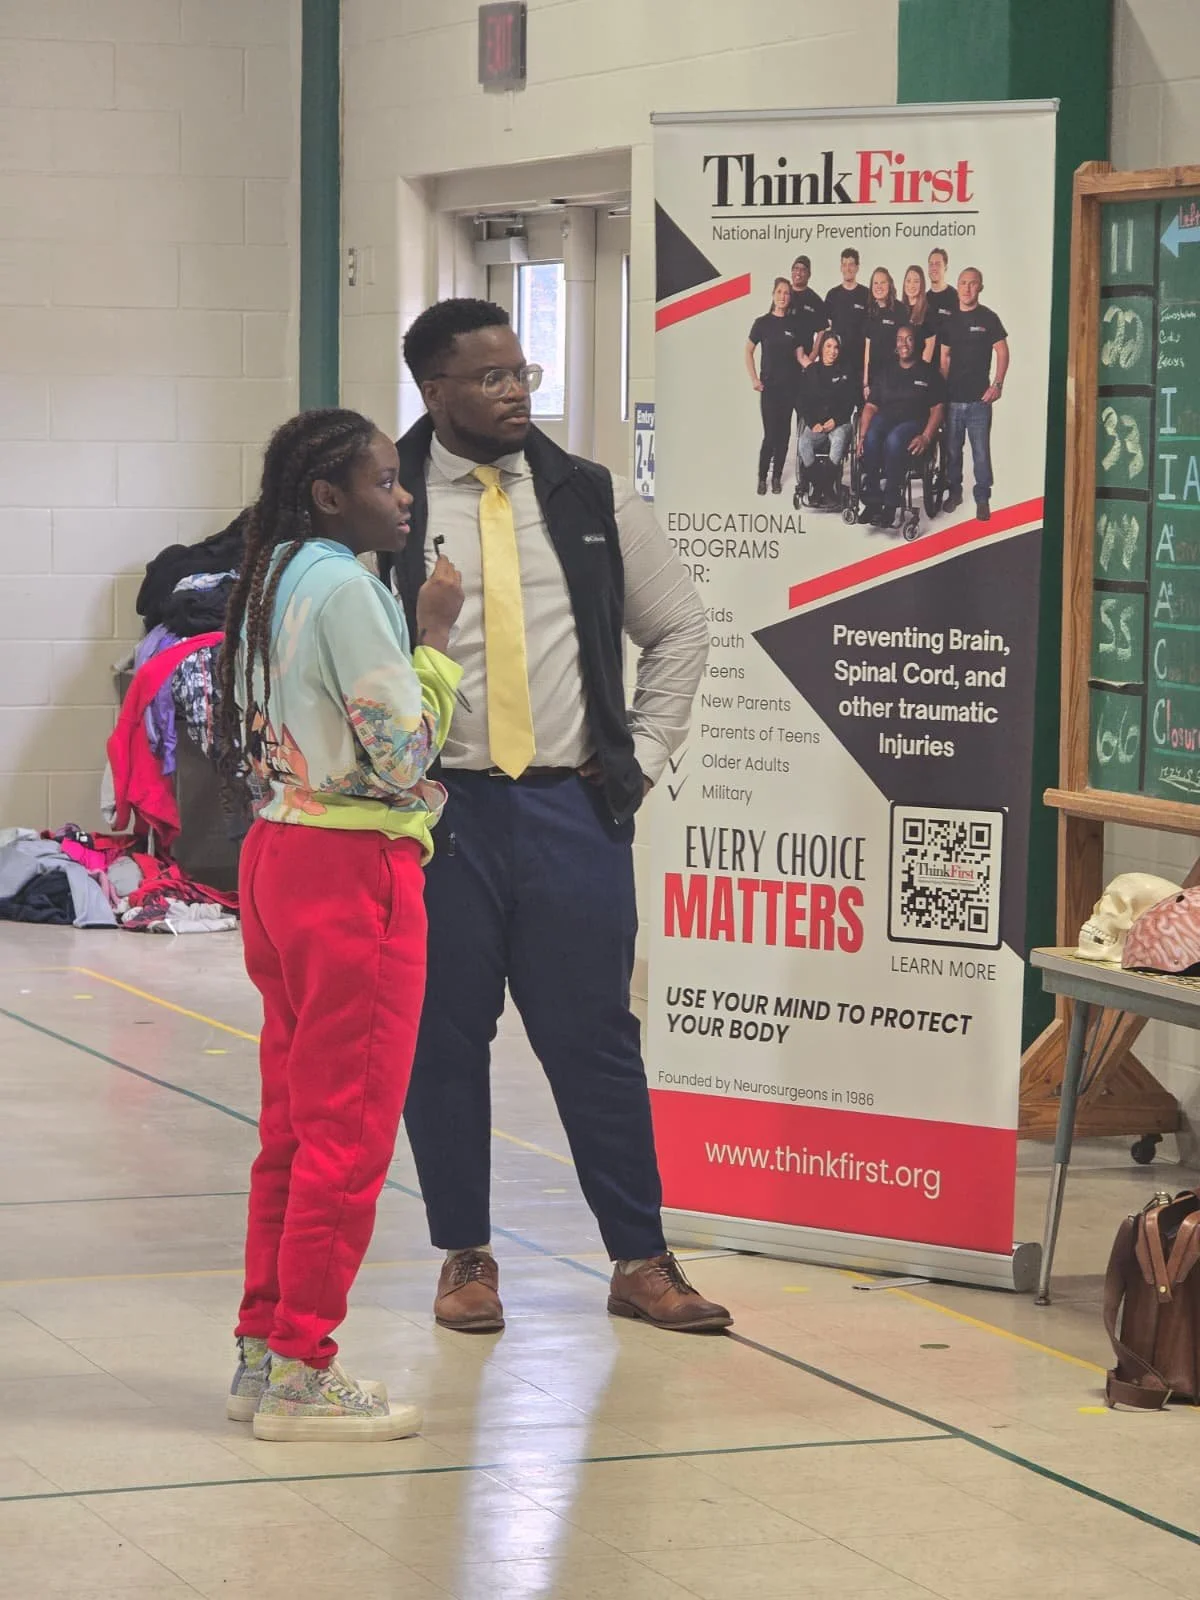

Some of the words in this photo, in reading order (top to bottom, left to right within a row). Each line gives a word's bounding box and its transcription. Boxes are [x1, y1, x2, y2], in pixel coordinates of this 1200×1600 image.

[703, 150, 974, 207] ThinkFirst
[712, 223, 770, 241] National
[773, 223, 812, 242] Injury
[816, 223, 890, 239] Prevention
[895, 221, 975, 238] Foundation
[637, 409, 654, 428] Entry
[669, 513, 806, 534] EDUCATIONAL
[711, 634, 745, 648] outh
[833, 624, 944, 654] Preventing
[949, 628, 1010, 656] Brain,
[703, 664, 745, 679] Teens
[834, 659, 898, 686] Spinal
[903, 663, 960, 689] Cord,
[964, 666, 1007, 688] and
[701, 694, 733, 709] New
[737, 695, 791, 711] Parents
[839, 695, 893, 718] other
[899, 698, 999, 723] traumatic
[701, 724, 755, 740] Parents
[759, 727, 774, 741] of
[777, 728, 820, 744] Teens
[1153, 698, 1200, 751] Closur
[879, 733, 954, 759] Injuries
[702, 754, 741, 769] Older
[745, 757, 790, 772] Adults
[702, 784, 752, 806] Military
[685, 825, 766, 873] EVERY
[777, 832, 866, 880] CHOICE
[916, 862, 974, 880] ThinkFirst
[664, 872, 864, 953] MATTERS
[891, 955, 943, 976] LEARN
[949, 960, 997, 981] MORE
[666, 986, 707, 1009] USE
[711, 990, 768, 1015] YOUR
[773, 996, 831, 1022] MIND
[837, 1002, 865, 1025] TO
[870, 1007, 972, 1036] PROTECT
[667, 1013, 725, 1039] YOUR
[729, 1018, 791, 1044] BODY
[658, 1070, 712, 1088] Founded
[715, 1075, 731, 1093] by
[734, 1078, 828, 1102] Neurosurgeons
[831, 1090, 843, 1103] in
[845, 1090, 874, 1107] 1986
[705, 1141, 941, 1199] www.thinkfirst.org
